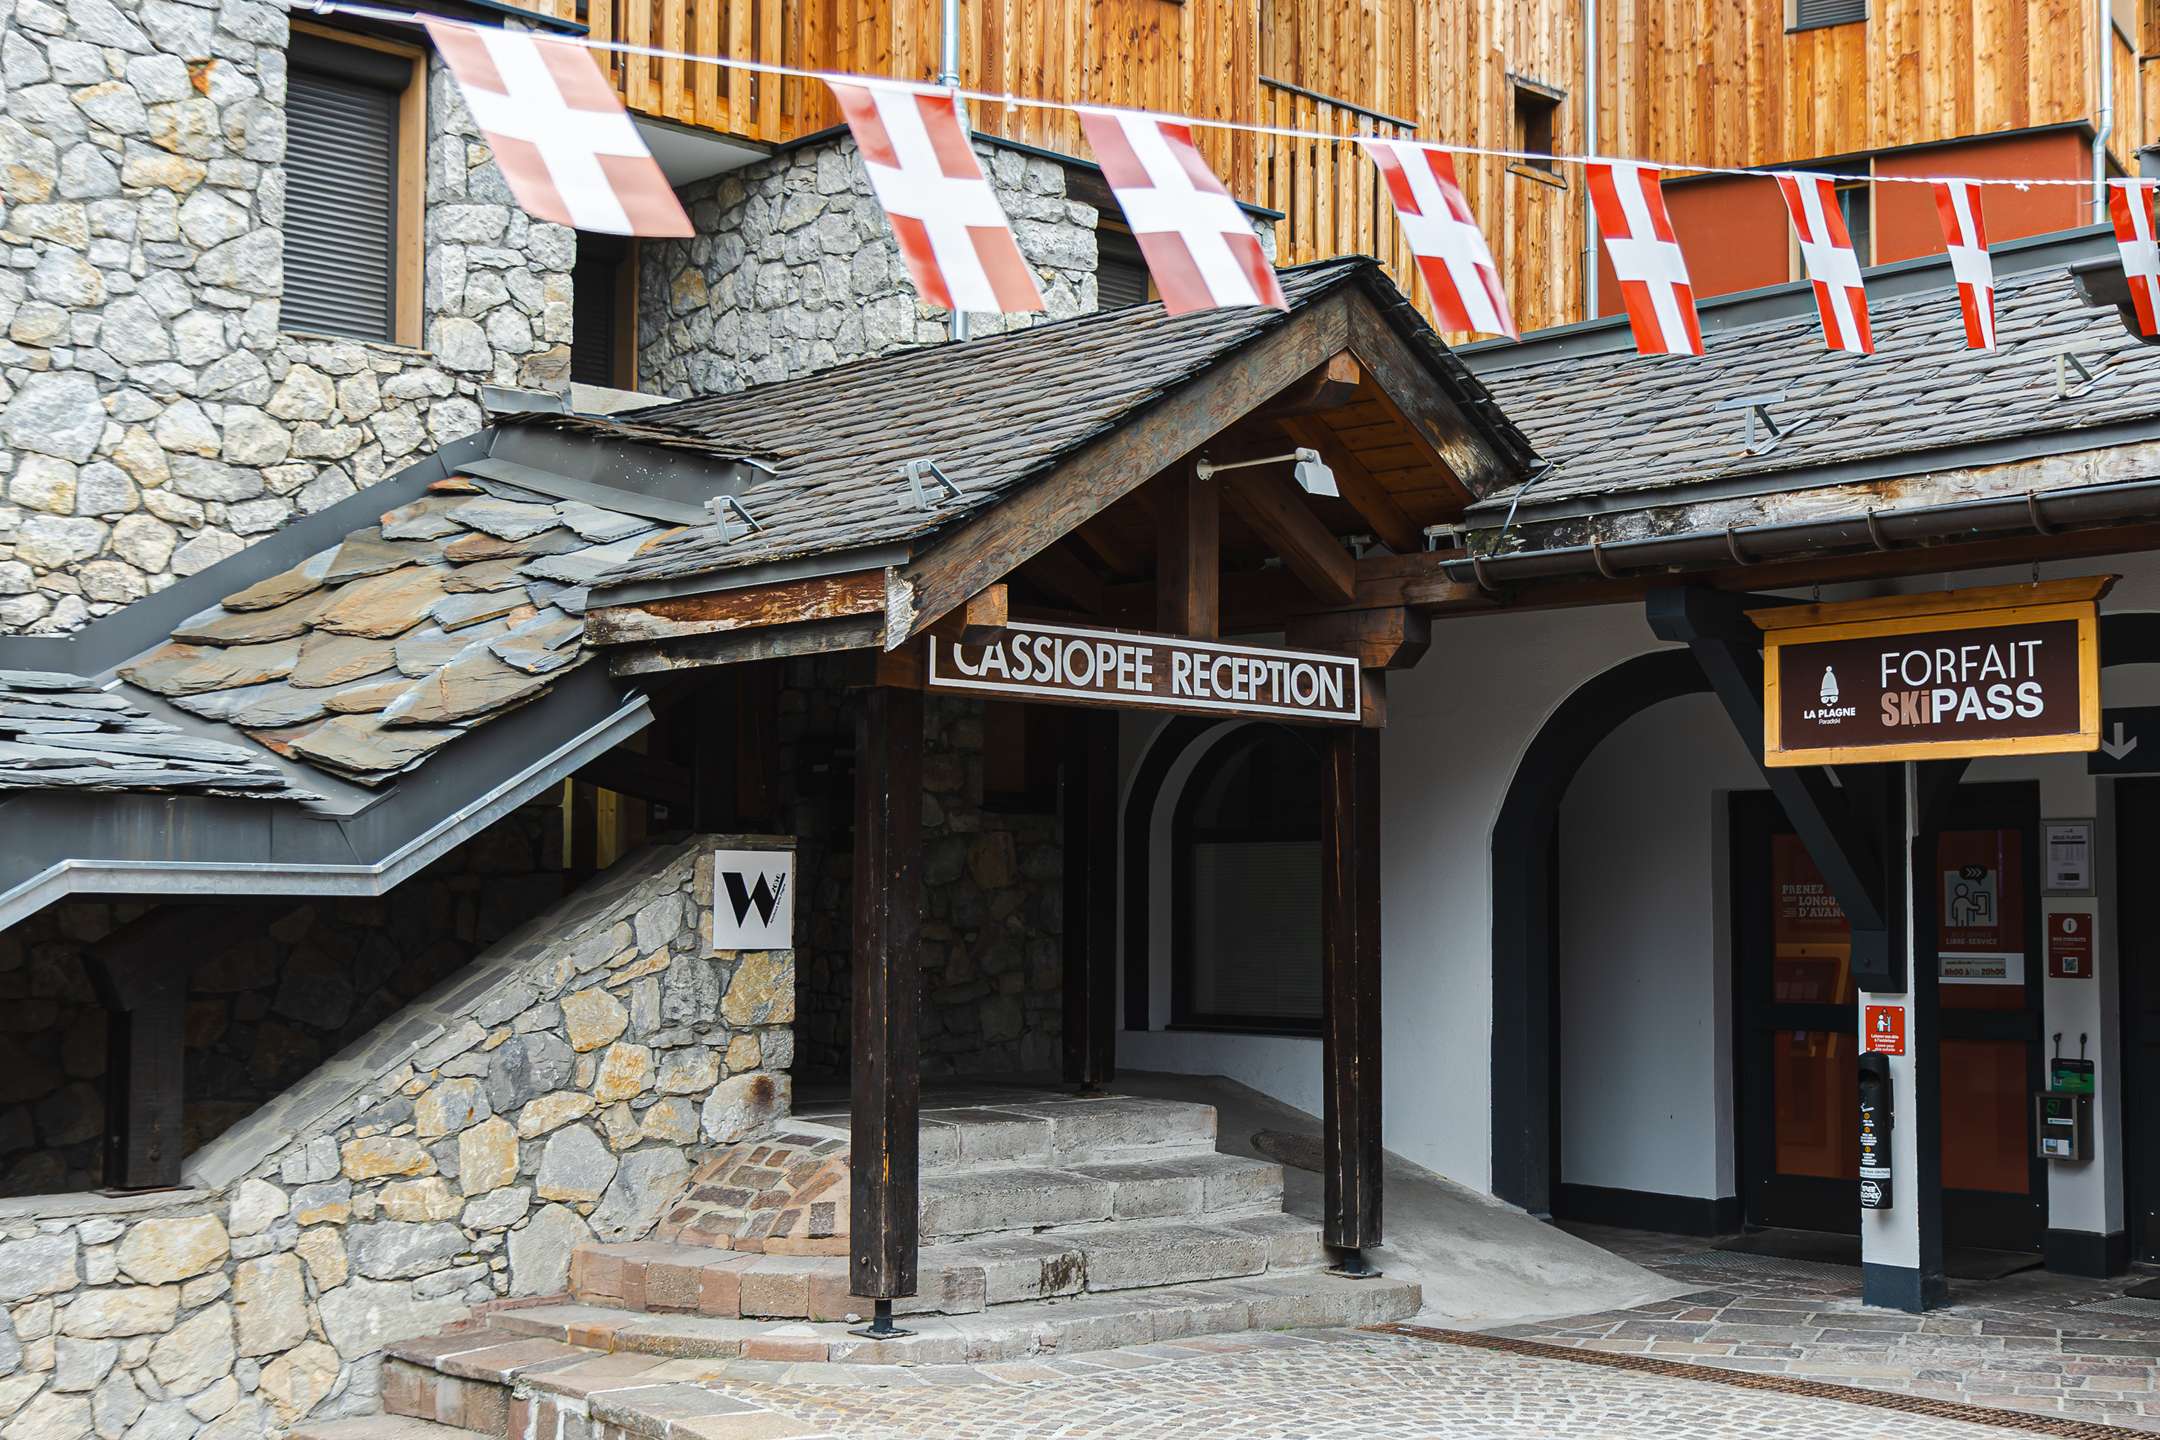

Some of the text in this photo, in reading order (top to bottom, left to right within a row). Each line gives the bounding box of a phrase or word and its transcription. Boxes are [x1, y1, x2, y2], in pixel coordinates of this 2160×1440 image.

[953, 633, 1344, 709] CASSIOPEE RECEPTION
[1881, 640, 2043, 688] FORFAIT
[1803, 707, 1856, 719] LA PLAGNE
[721, 871, 786, 929] W
[1799, 895, 1839, 906] LONGU
